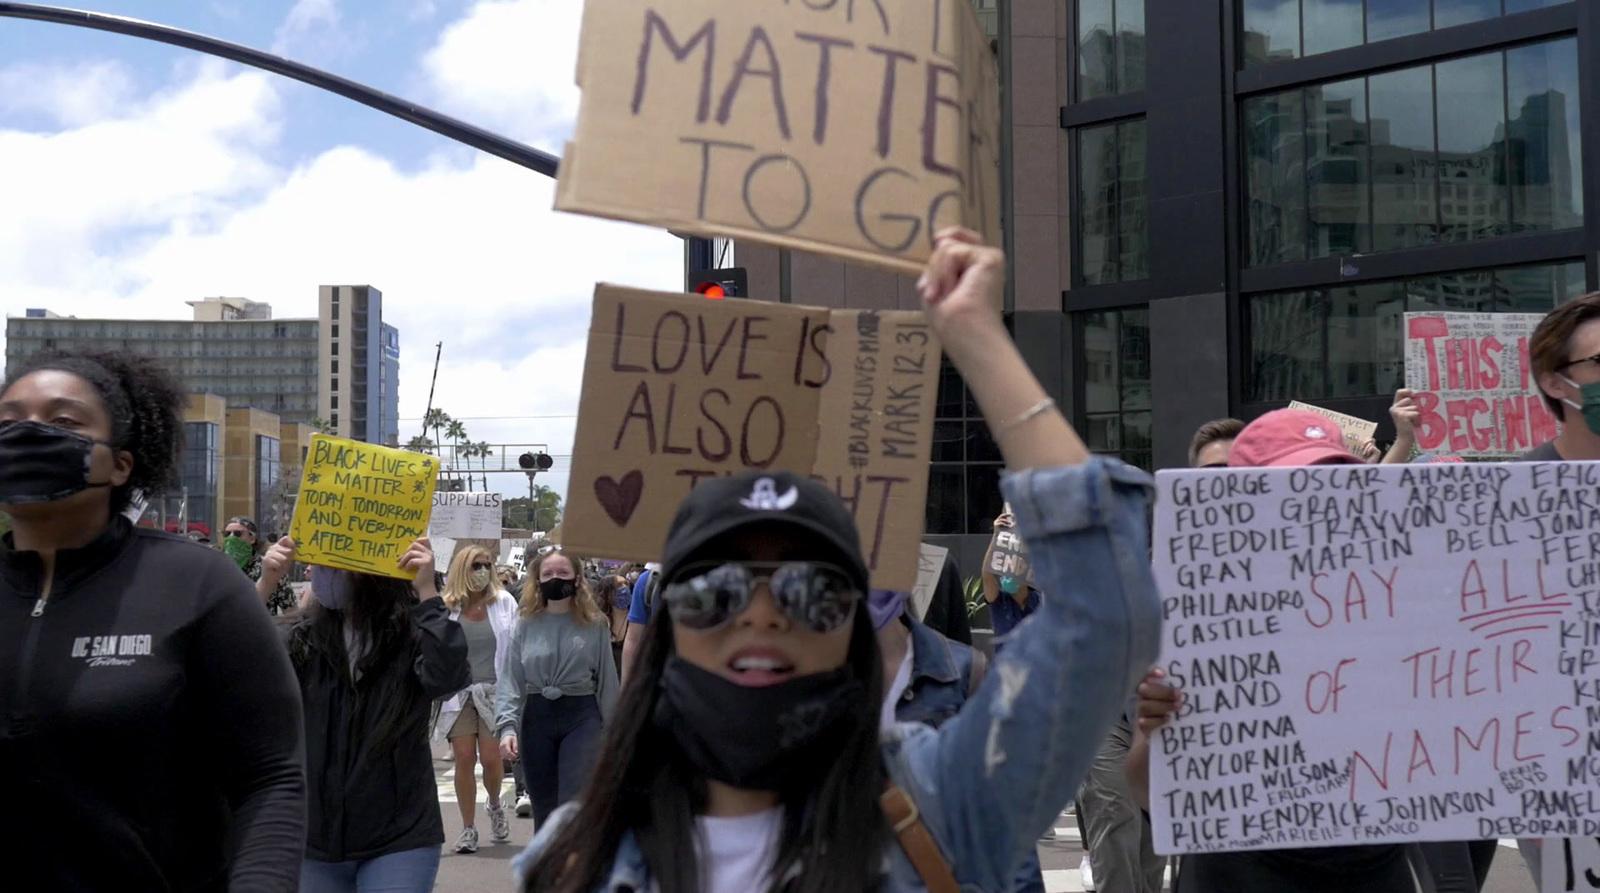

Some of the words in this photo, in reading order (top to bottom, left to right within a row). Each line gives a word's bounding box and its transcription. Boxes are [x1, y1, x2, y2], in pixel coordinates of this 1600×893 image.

[680, 137, 810, 232] TO
[611, 302, 772, 380] LOVE
[794, 315, 836, 388] IS
[1407, 316, 1504, 391] THIS
[613, 380, 785, 468] ALSO
[881, 383, 925, 459] MARK
[314, 439, 367, 470] BLACK
[371, 452, 418, 478] LIVES
[333, 471, 406, 496] MATTER
[432, 492, 500, 508] SUPPLIES
[1172, 472, 1272, 507] GEORGE
[1289, 467, 1387, 494] OSCAR
[1399, 465, 1512, 488] AHMAUD
[307, 508, 342, 527] AND
[1176, 501, 1255, 532] FLOYD
[1280, 488, 1382, 523] GRANT
[1408, 481, 1503, 506] ARBERY
[1538, 486, 1600, 513] GAR
[308, 529, 354, 552] AFTER
[358, 539, 400, 559] THAT!
[1169, 526, 1299, 564] FREDDIE
[1302, 500, 1446, 547] TRAYVON
[1456, 497, 1530, 527] SEAN
[1177, 557, 1253, 590] GRAY
[1289, 531, 1413, 580] MARTIN
[1447, 524, 1519, 553] BELL
[1163, 589, 1304, 620] PHILANDRO
[1305, 566, 1399, 629] SAY
[1460, 557, 1567, 612] ALL
[71, 637, 91, 657] UC
[91, 635, 118, 657] SAN
[119, 634, 152, 656] DIEGO
[1174, 614, 1281, 648] CASTILE
[1169, 650, 1281, 690] SANDRA
[1305, 657, 1357, 715] OF
[1401, 639, 1538, 699] THEIR
[1174, 680, 1282, 720] BLAND
[1161, 715, 1296, 756] BREONNA
[1350, 705, 1580, 802] NAMES
[1167, 749, 1259, 781] TAYLOR
[1263, 739, 1306, 770] NIA
[1261, 758, 1338, 790] WILSON
[1164, 783, 1259, 819] TAMIR
[1172, 817, 1230, 848] RICE
[1242, 801, 1369, 837] KENDRICK
[1376, 788, 1496, 825] JOHNSON
[1352, 821, 1419, 841] FRANCO
[1477, 816, 1577, 839] DEBORAH
